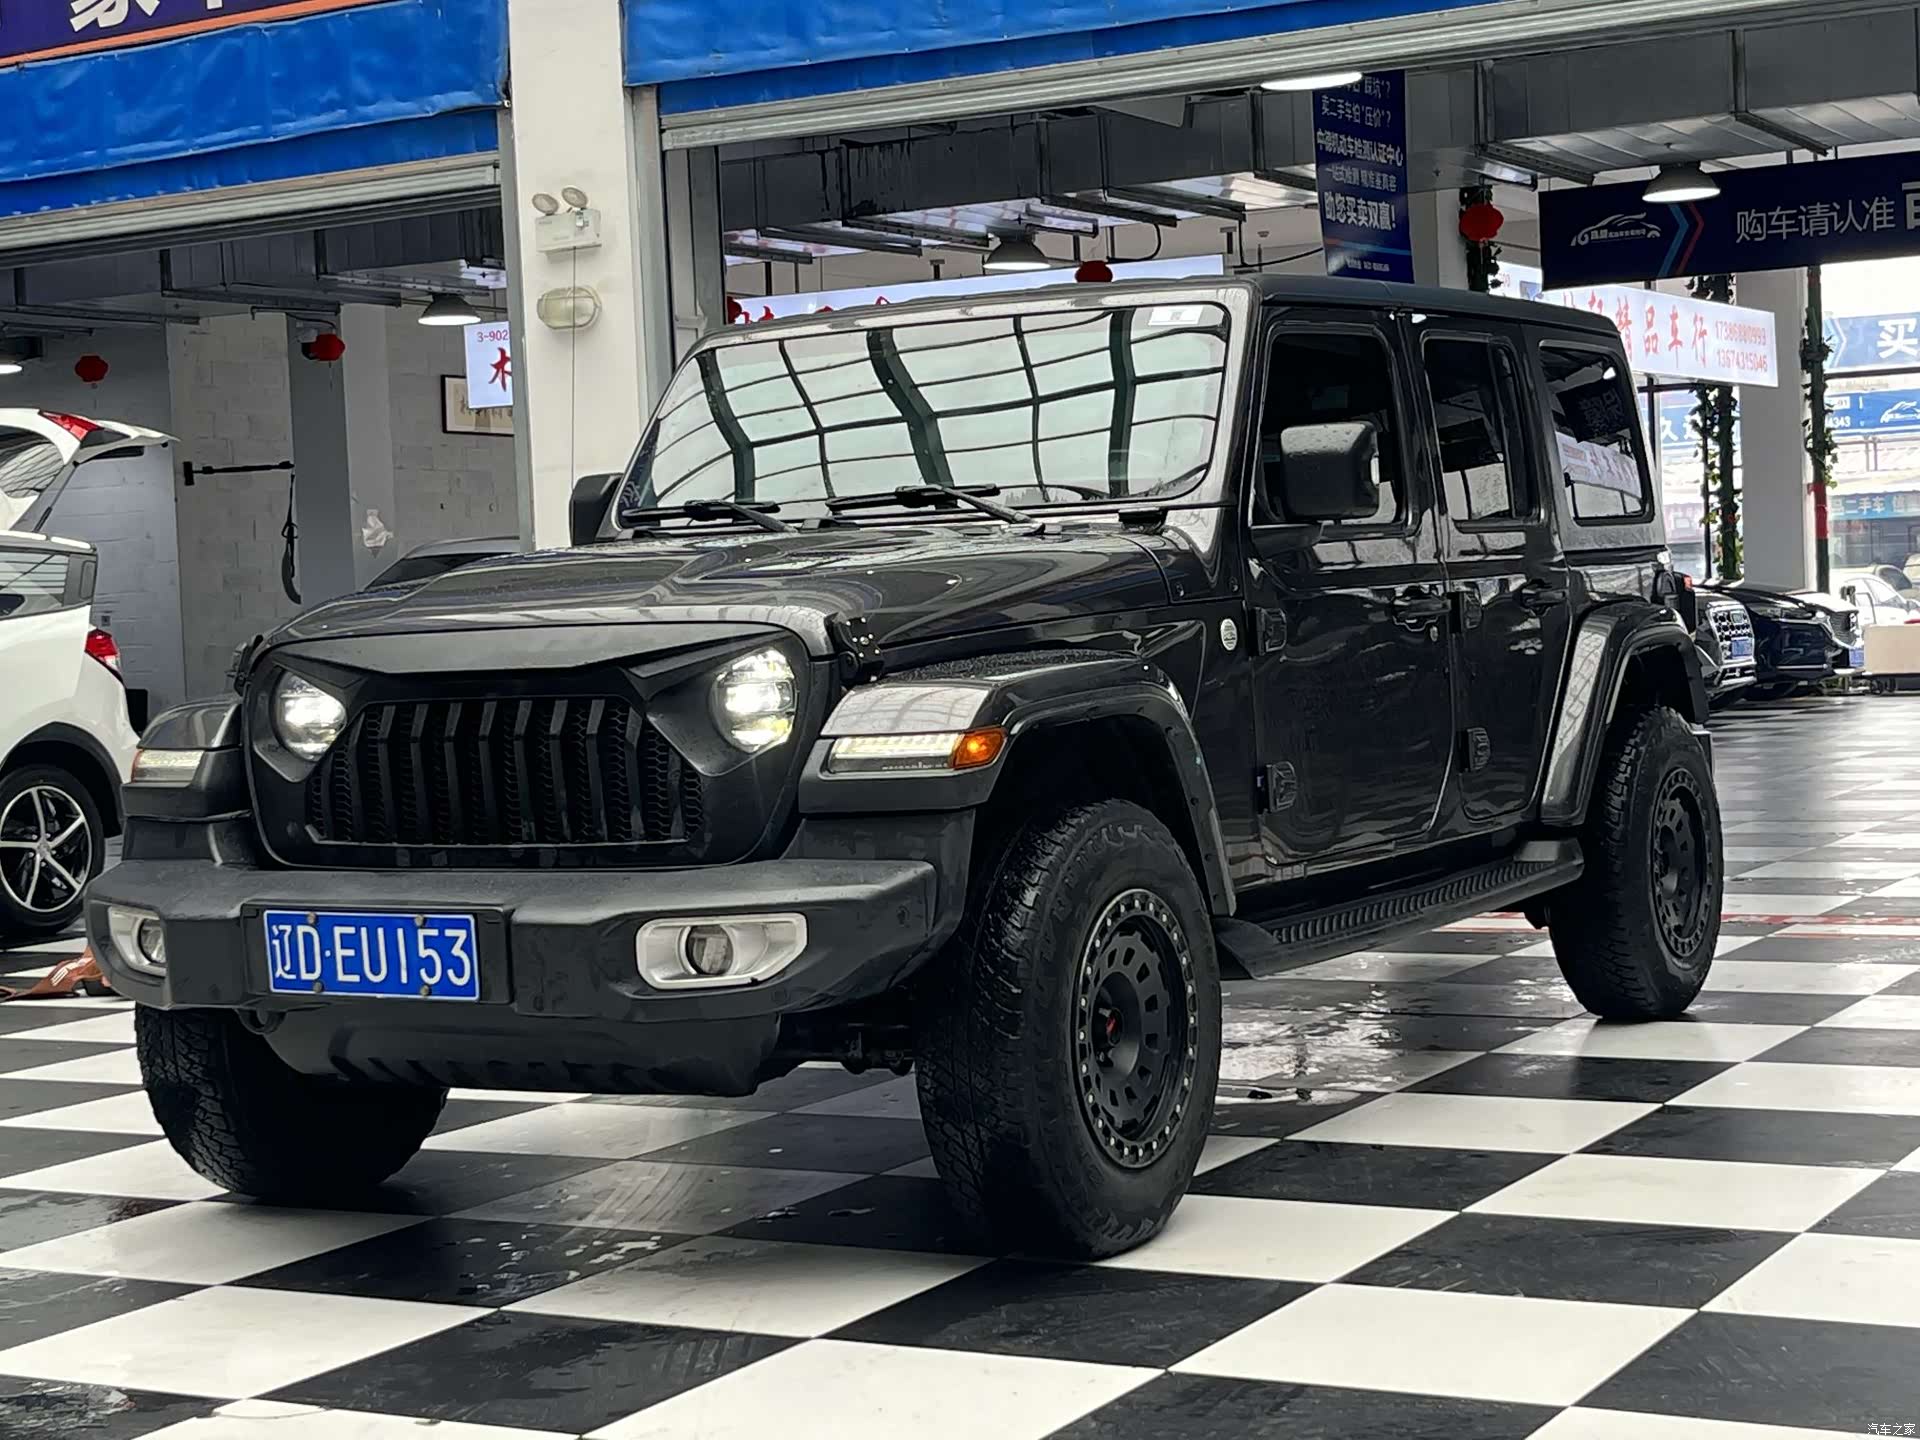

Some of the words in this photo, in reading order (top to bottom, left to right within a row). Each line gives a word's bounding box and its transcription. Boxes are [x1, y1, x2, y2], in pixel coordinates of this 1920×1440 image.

[1736, 197, 1895, 243] 购车请认准
[1877, 318, 1918, 358] 买
